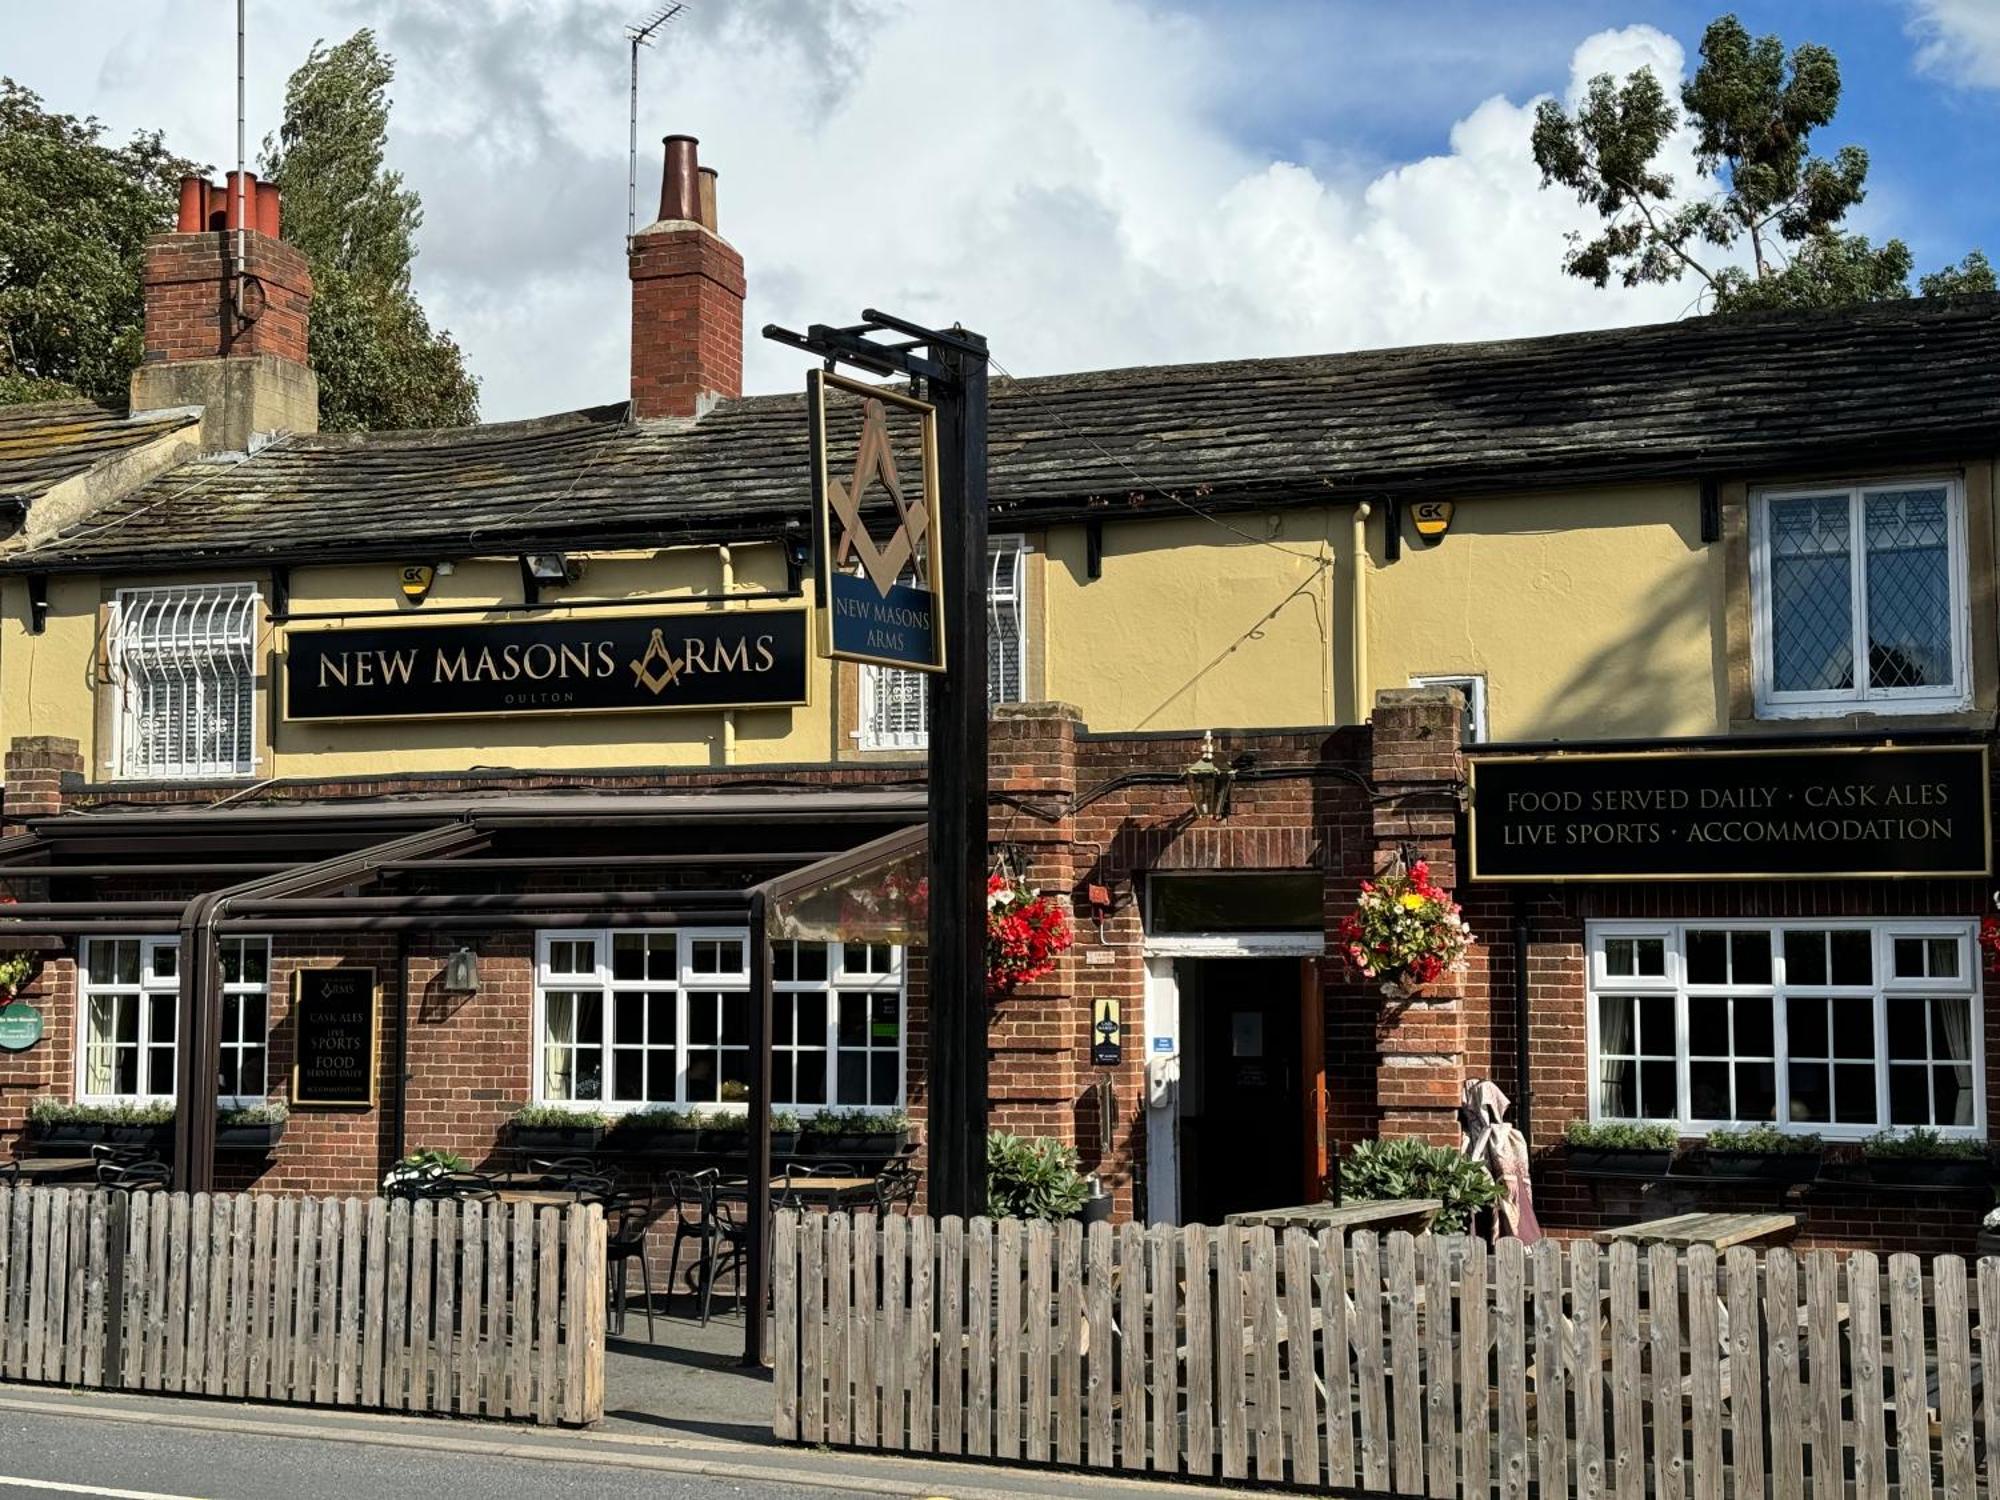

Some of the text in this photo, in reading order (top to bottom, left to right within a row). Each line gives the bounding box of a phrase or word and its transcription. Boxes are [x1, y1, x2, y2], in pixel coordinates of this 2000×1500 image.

[1419, 504, 1442, 517] GK
[403, 568, 423, 581] GK
[836, 597, 929, 630] NEW MASONS
[867, 630, 905, 651] ARMS
[317, 649, 418, 688] NEW
[433, 640, 616, 684] MASONS
[505, 692, 574, 704] OULTON
[1508, 783, 1949, 813] FOOD SERVED DAILY CASK ALES
[1504, 818, 1954, 845] LIVE SPORTS ACCOMMODATION
[310, 1012, 364, 1023] CASK ALES
[311, 1036, 361, 1050] SPORTS
[316, 1055, 354, 1069] FOOD
